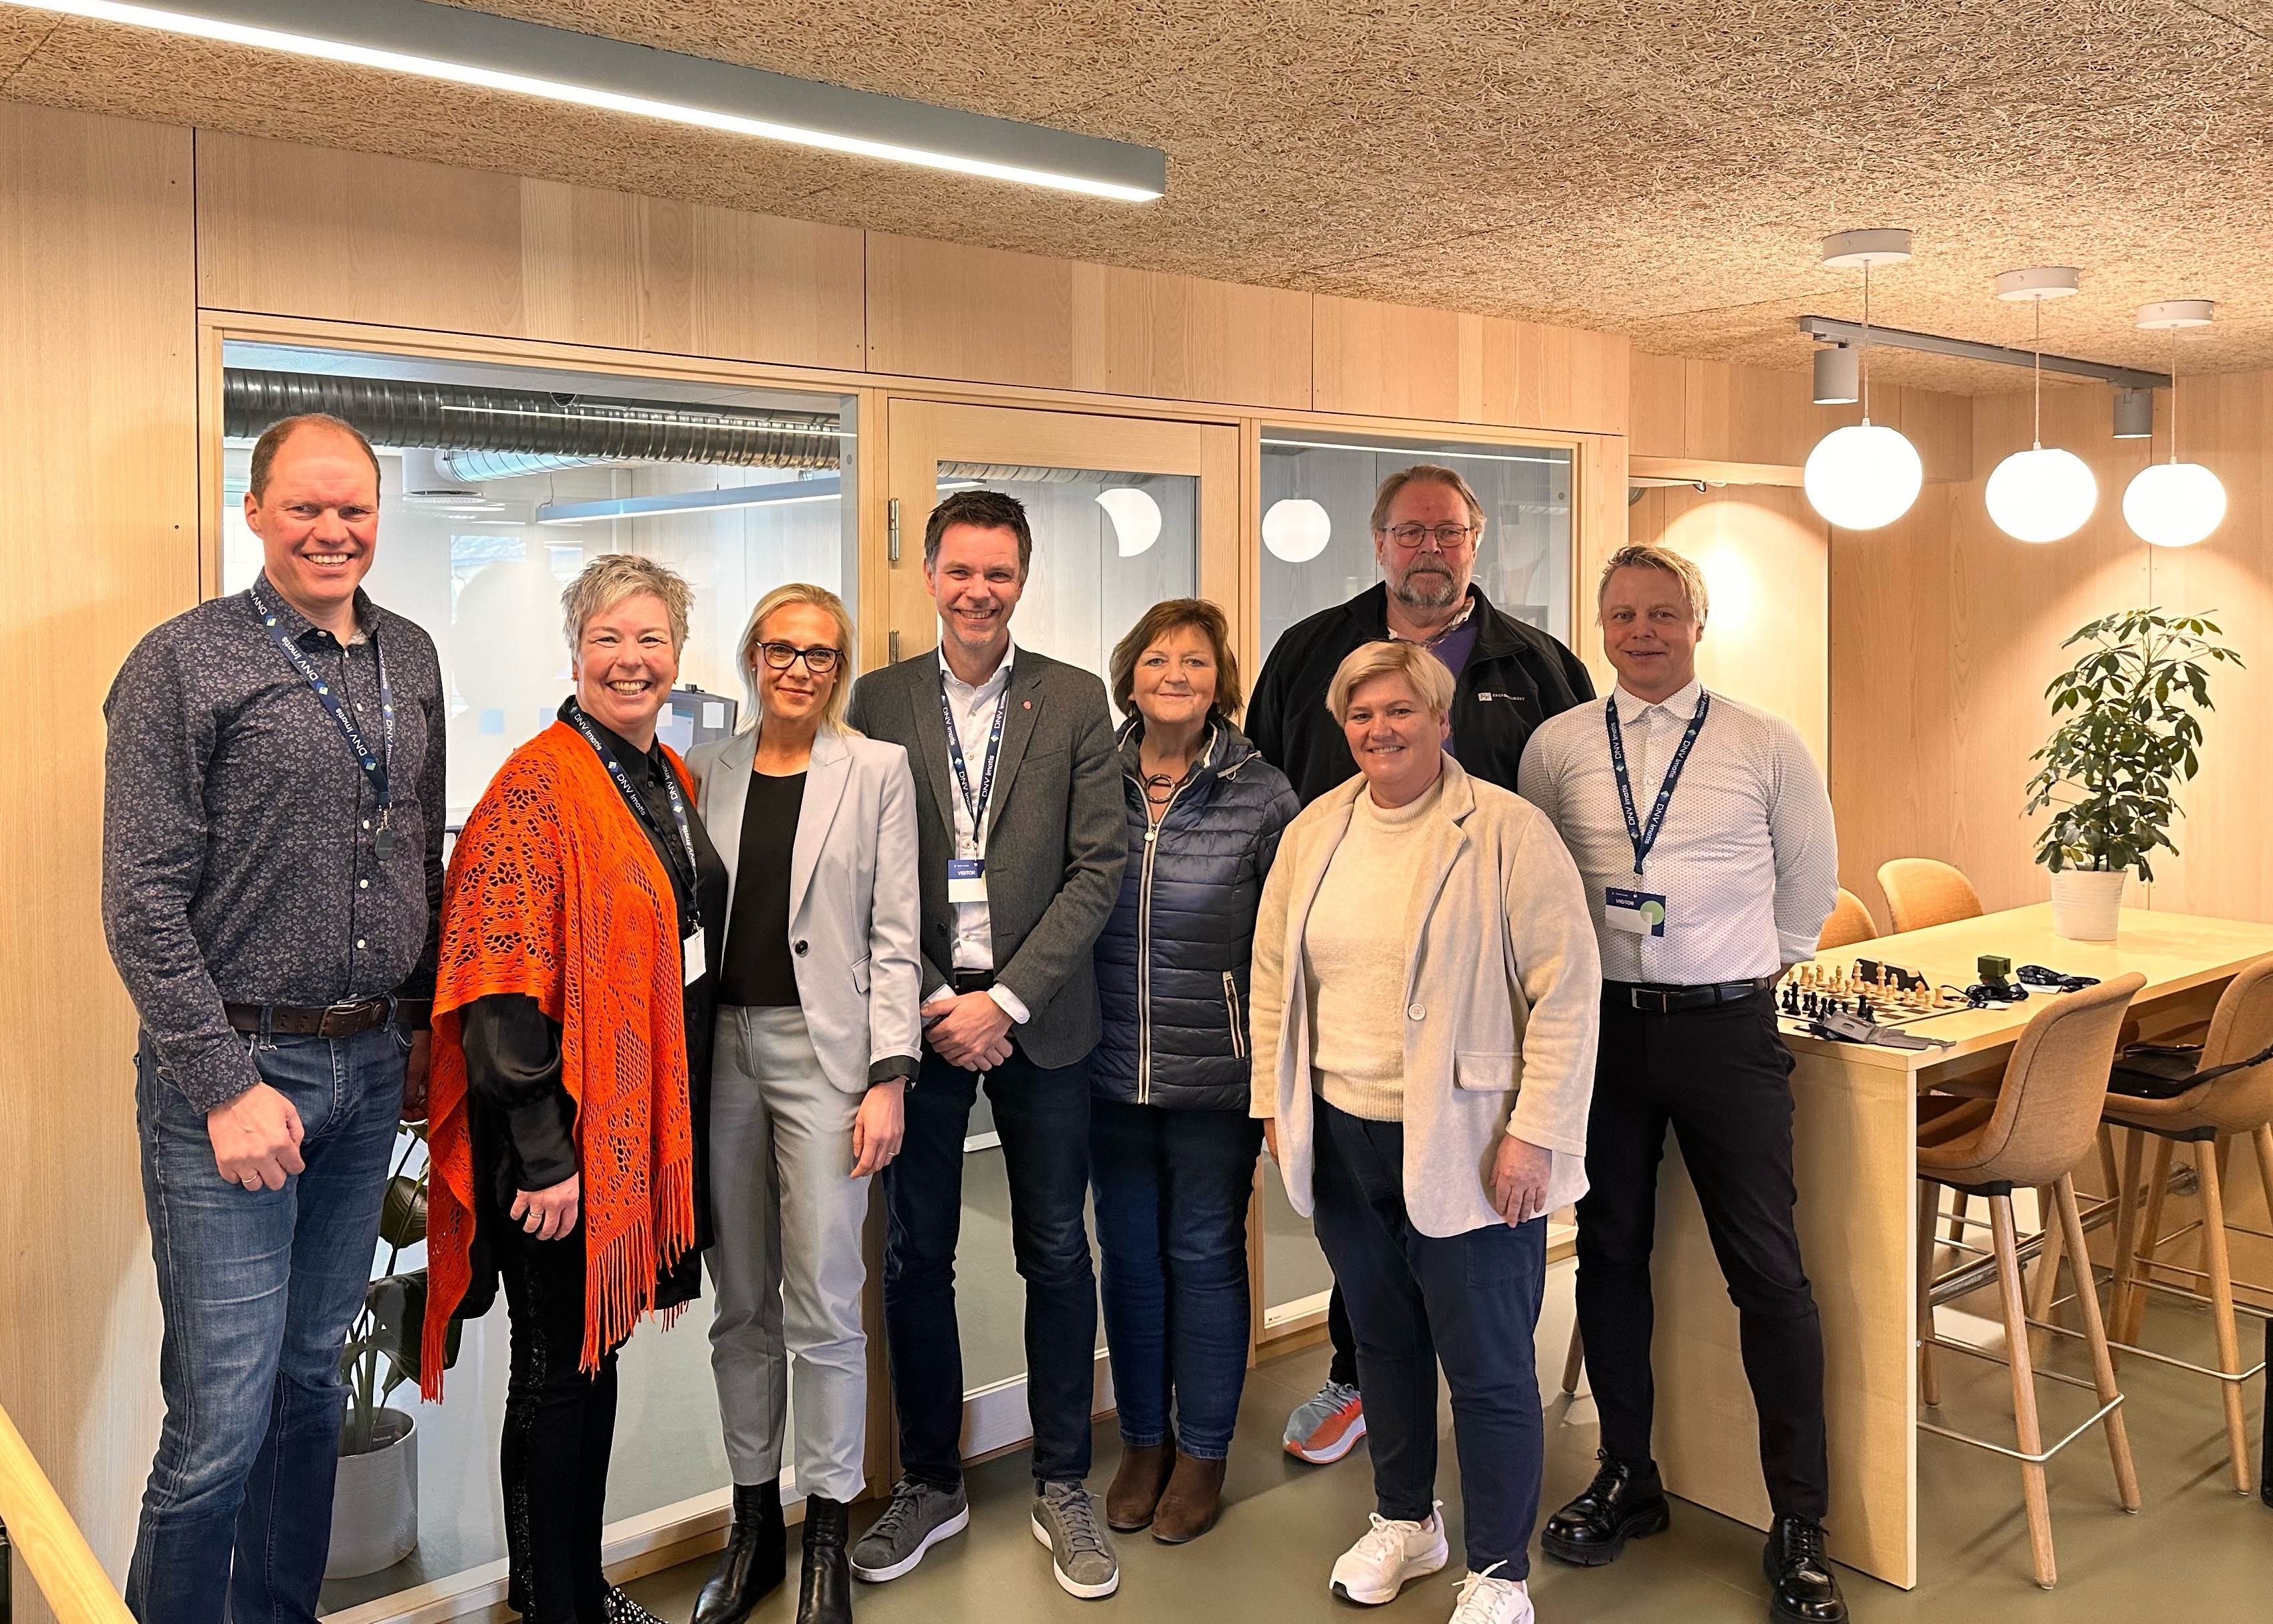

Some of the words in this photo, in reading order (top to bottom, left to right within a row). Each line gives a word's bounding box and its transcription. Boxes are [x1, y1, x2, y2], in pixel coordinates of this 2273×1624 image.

[253, 596, 267, 616] DNV
[281, 636, 302, 660] Imatis
[297, 660, 319, 681] DNV
[335, 707, 354, 733] Imatis
[943, 707, 952, 725] DNV
[993, 709, 1003, 729] DNV
[385, 719, 393, 743] DNV
[574, 713, 590, 730] DNV
[585, 729, 602, 751] Imatis
[947, 725, 956, 746] Imatis
[1610, 722, 1619, 741] Imatis
[349, 734, 368, 757] DNV
[1612, 741, 1622, 760] DNV
[1678, 740, 1691, 760] DNV
[985, 755, 995, 776] Imatis
[1669, 760, 1682, 779] Imatis
[666, 781, 679, 800] DNV
[959, 771, 969, 790] DNV
[982, 776, 991, 798] DNV
[616, 773, 634, 794] DNV
[630, 794, 646, 816] Imatis
[1622, 784, 1631, 806] Imatis
[1625, 806, 1636, 826] DNV
[1651, 803, 1665, 824] DNV
[1644, 823, 1657, 845] Imatis
[1615, 898, 1635, 907] VISITOR
